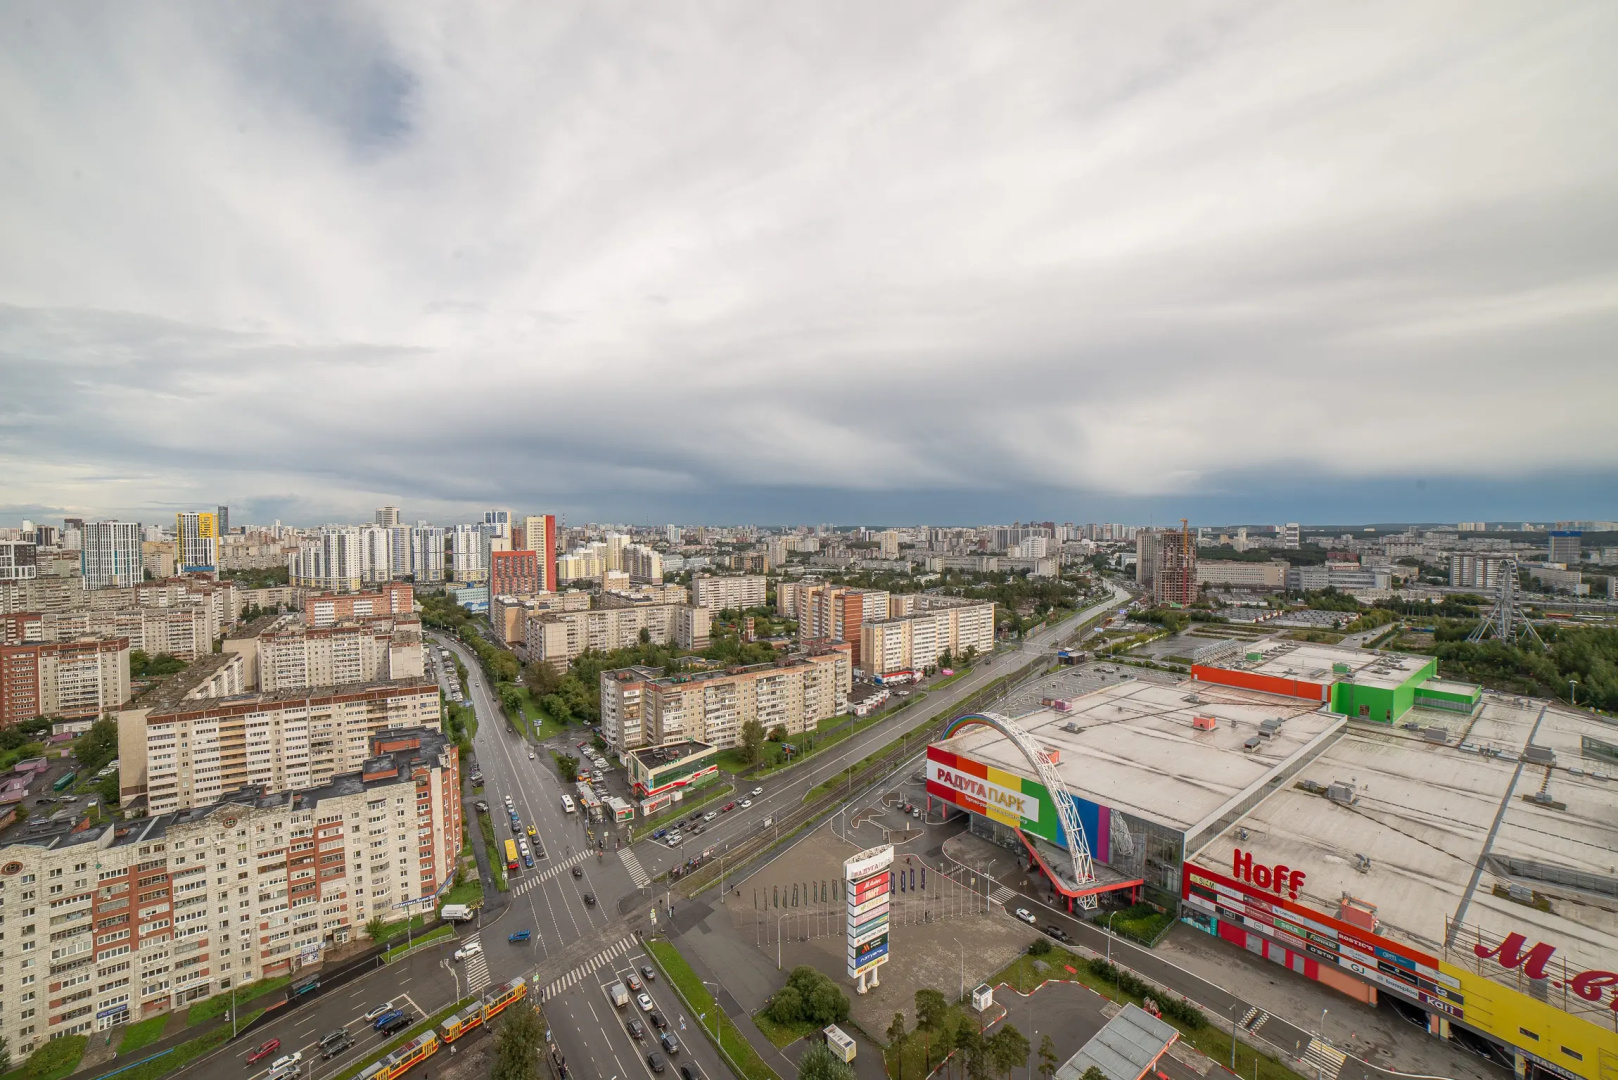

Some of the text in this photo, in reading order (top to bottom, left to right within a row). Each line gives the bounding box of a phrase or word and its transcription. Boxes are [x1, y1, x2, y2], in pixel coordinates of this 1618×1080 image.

[937, 768, 987, 798] РАДУГА
[988, 787, 1026, 814] ПАРК
[1233, 848, 1306, 895] Hoff
[1350, 963, 1365, 974] GJ
[1426, 994, 1455, 1014] kari
